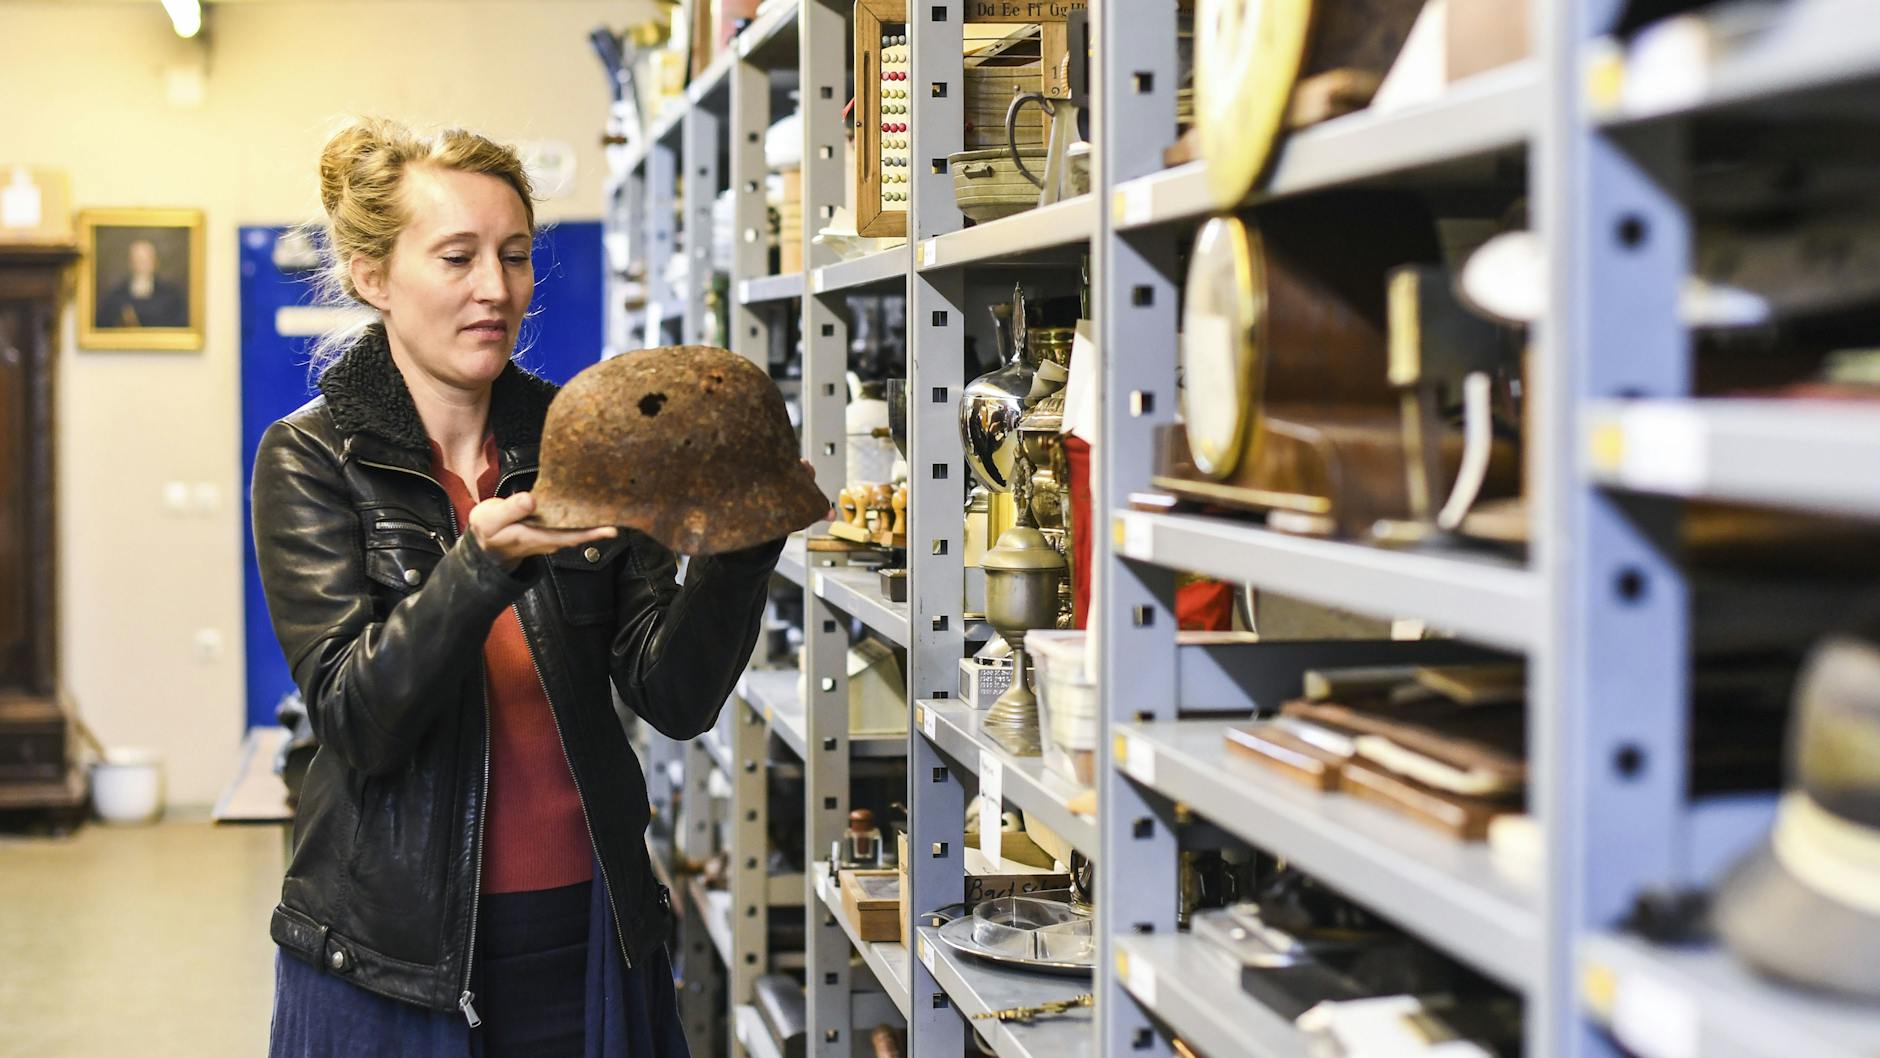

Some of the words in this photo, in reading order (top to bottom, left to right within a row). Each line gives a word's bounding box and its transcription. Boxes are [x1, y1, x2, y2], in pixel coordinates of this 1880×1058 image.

[977, 2, 995, 17] Dd
[1002, 2, 1020, 17] Ee
[1028, 2, 1042, 17] Ff
[1049, 2, 1067, 17] Gg
[1051, 65, 1058, 80] 1
